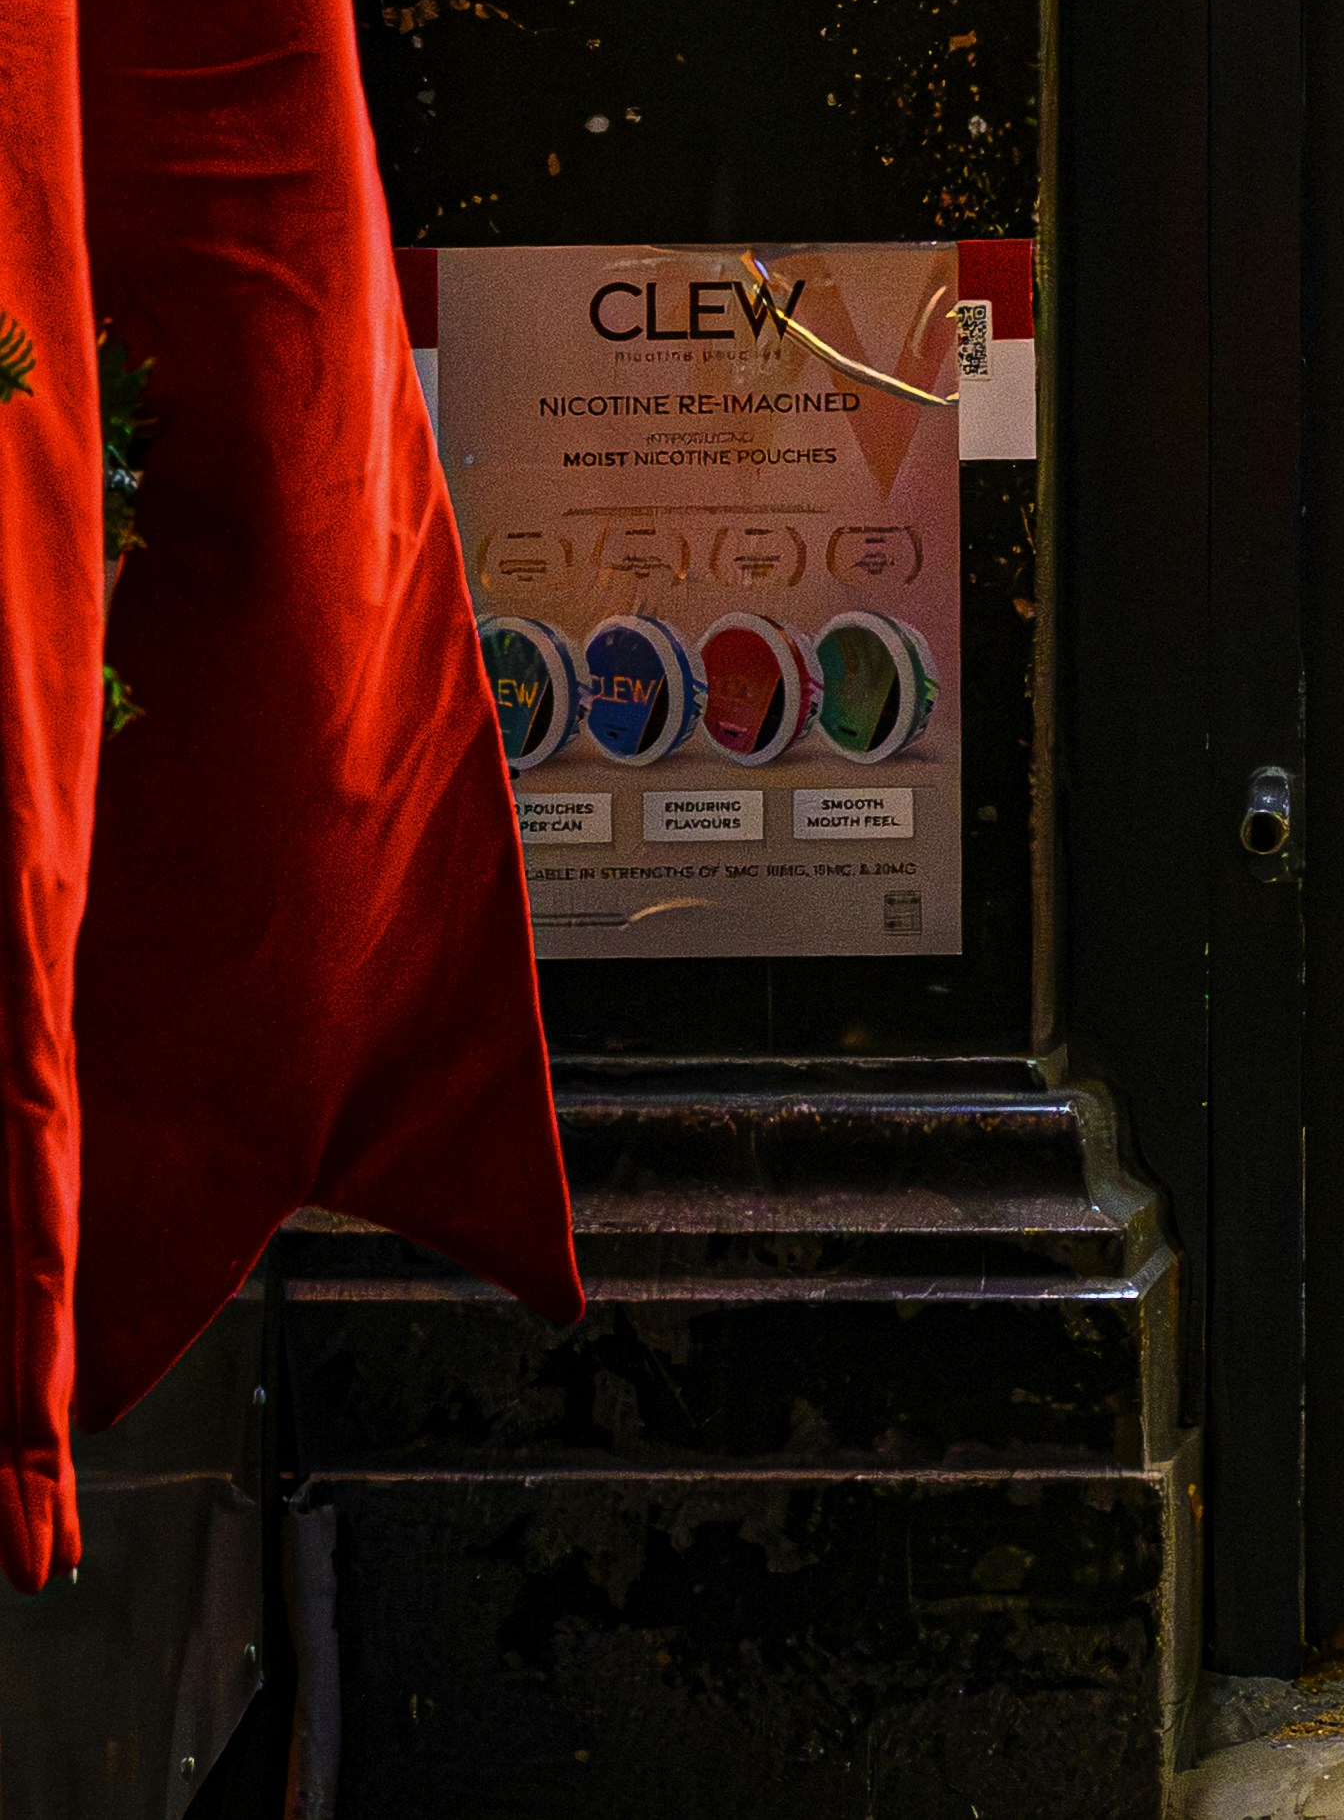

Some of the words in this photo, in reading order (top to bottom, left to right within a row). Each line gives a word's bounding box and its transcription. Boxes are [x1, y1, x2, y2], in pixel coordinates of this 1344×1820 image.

[588, 278, 806, 342] CLEW
[539, 395, 670, 417] NICOTINE
[677, 392, 861, 415] RE-IMAGINED
[563, 451, 630, 468] MOIST
[634, 449, 732, 467] NICOTINE
[737, 447, 838, 465] POUCHES
[523, 802, 594, 816] POUCHES
[663, 799, 742, 814] ENDURING
[820, 798, 885, 812] SMOOTH
[551, 819, 583, 832] CAN
[665, 816, 742, 831] FLAVOURS
[806, 815, 860, 829] MOUTH
[863, 813, 900, 827] FEEL
[600, 866, 694, 881] STRENGTHS
[698, 866, 719, 878] OF
